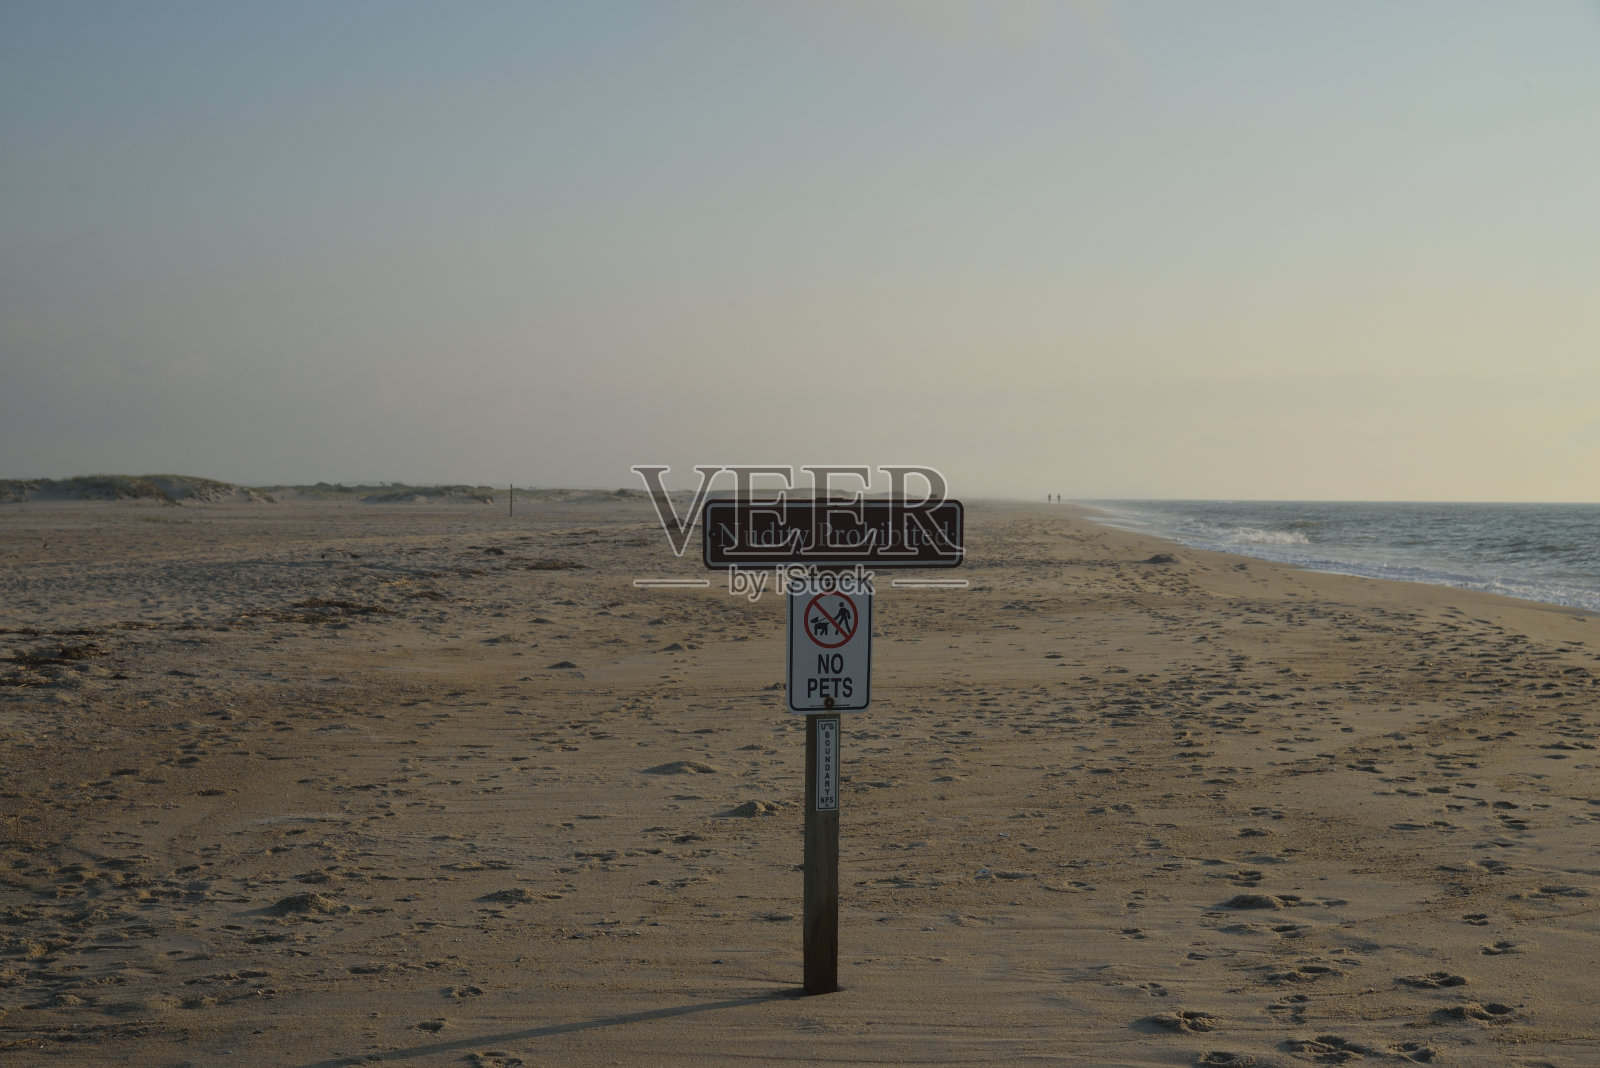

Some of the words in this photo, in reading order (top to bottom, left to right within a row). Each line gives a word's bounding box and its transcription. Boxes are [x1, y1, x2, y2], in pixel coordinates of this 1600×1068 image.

[717, 522, 810, 555] Nudity
[818, 520, 951, 547] Prohibited
[817, 654, 844, 675] NO
[808, 677, 853, 699] PETS
